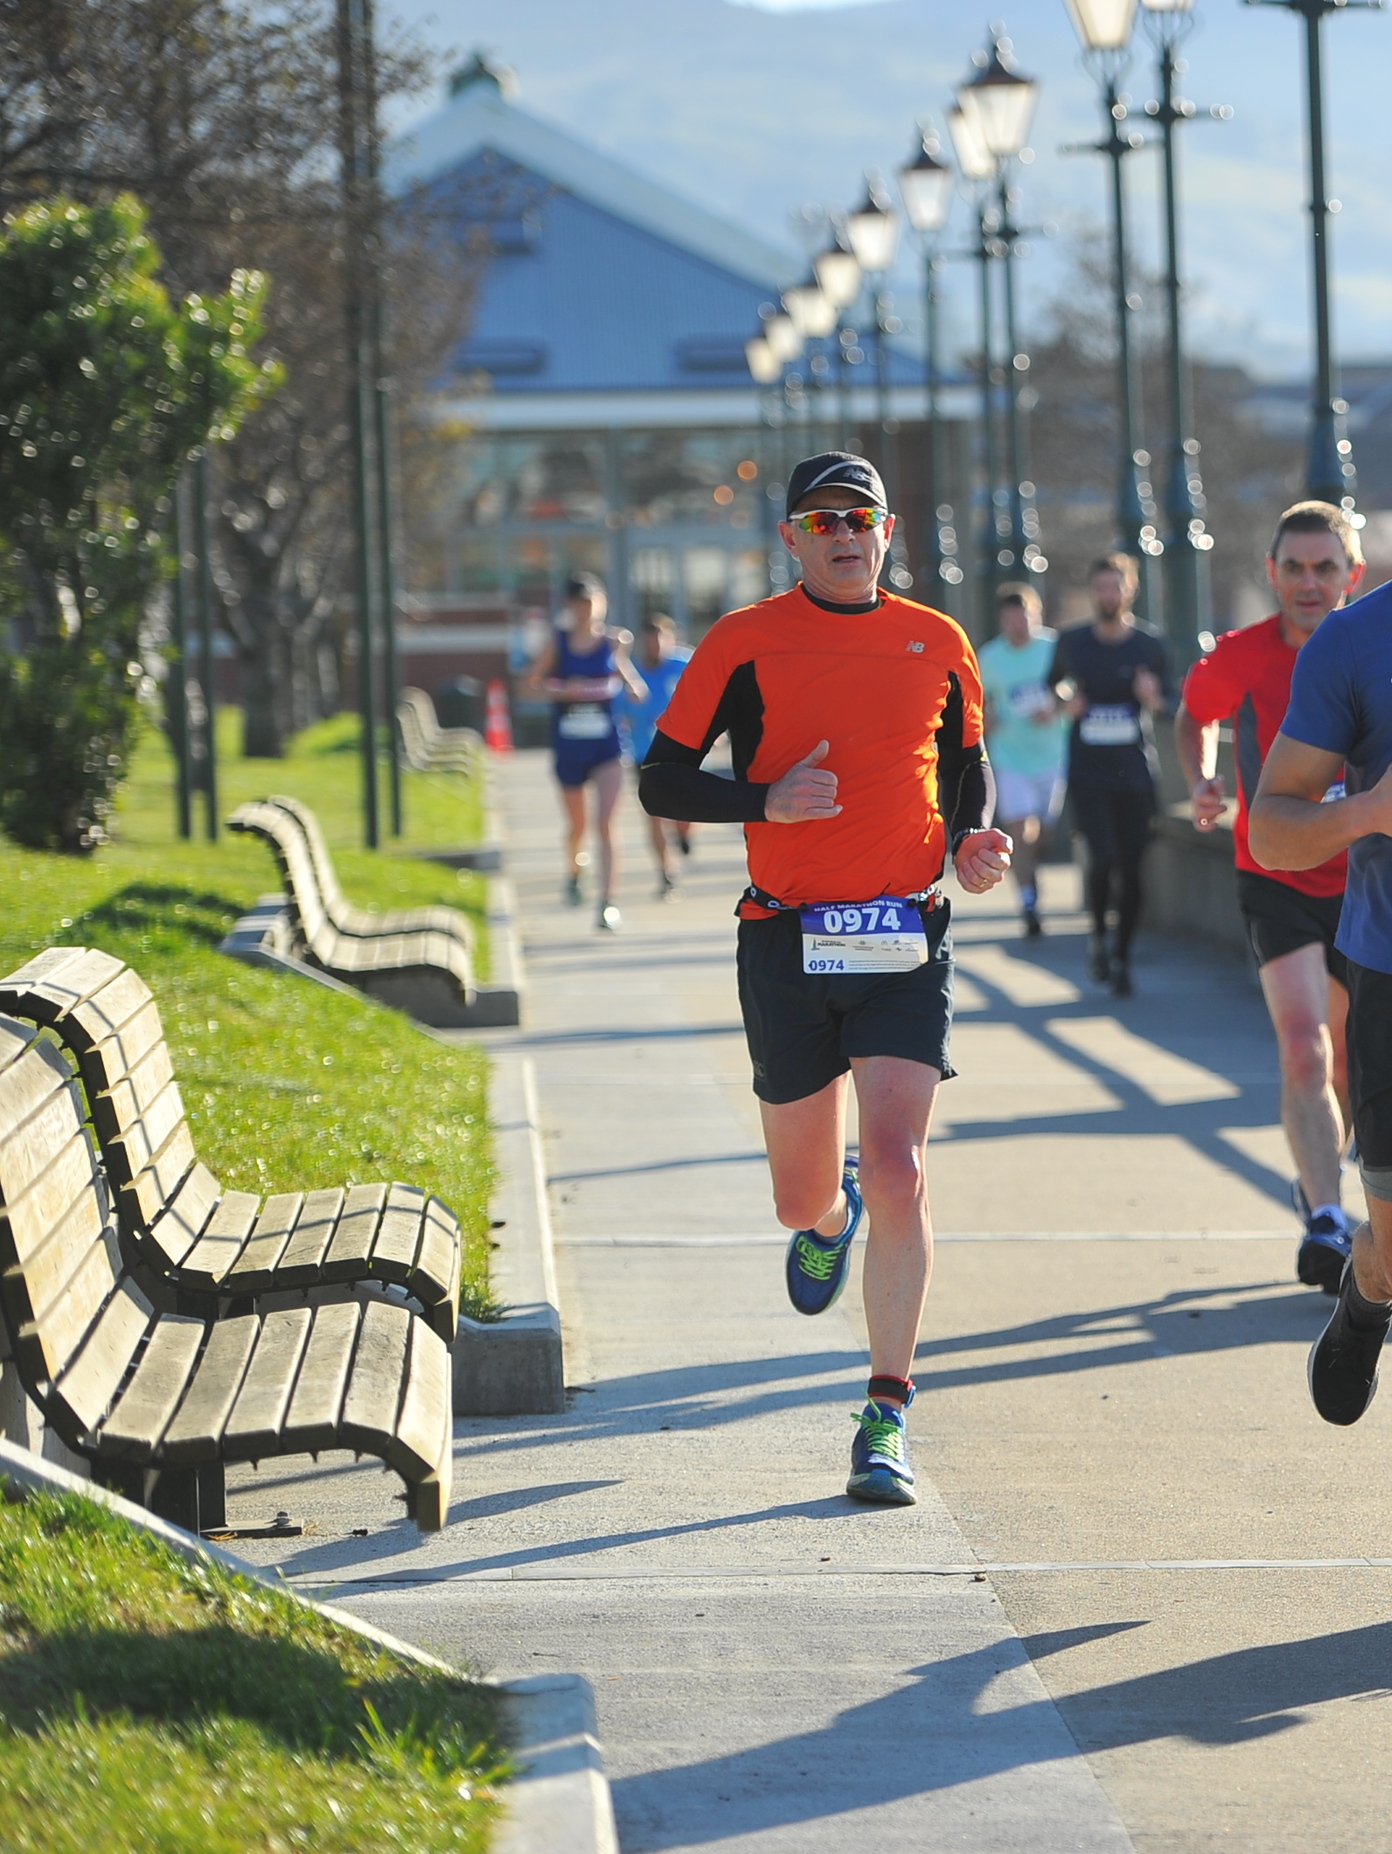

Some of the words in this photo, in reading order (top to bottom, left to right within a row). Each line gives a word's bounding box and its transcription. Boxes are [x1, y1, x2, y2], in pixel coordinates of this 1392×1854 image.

[837, 900, 885, 909] MARATHON
[886, 900, 903, 909] RUN
[823, 907, 901, 934] 0974
[809, 959, 845, 971] 0974
